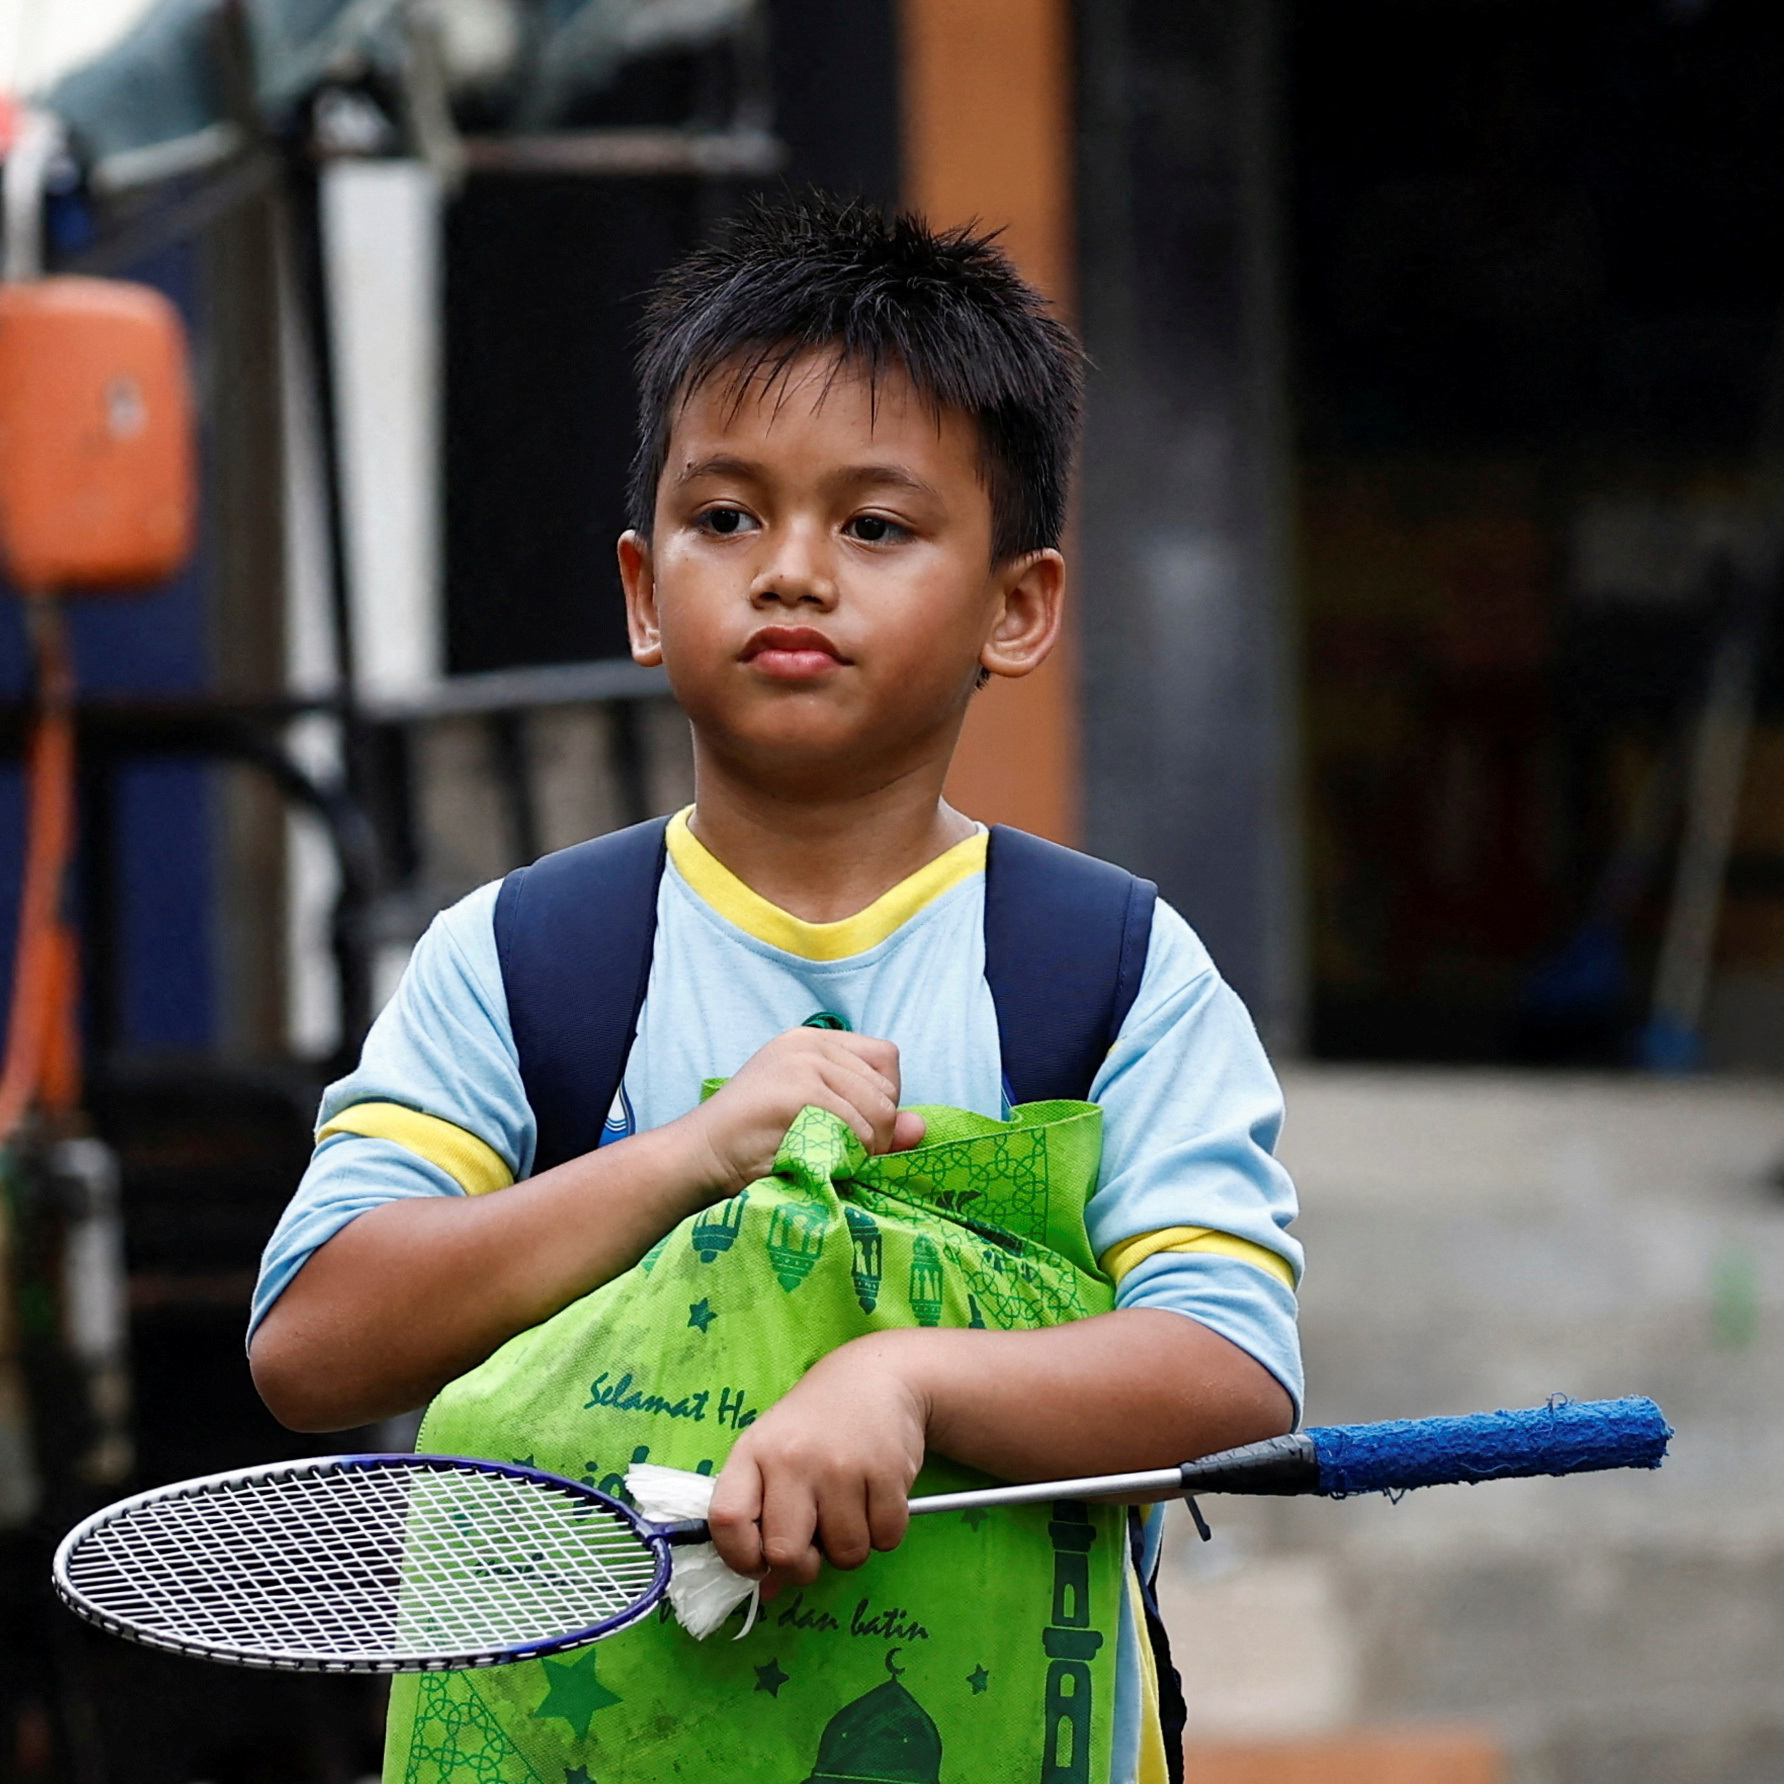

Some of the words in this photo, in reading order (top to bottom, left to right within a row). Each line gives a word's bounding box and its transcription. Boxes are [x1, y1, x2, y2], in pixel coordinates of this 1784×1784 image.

[583, 1371, 710, 1423] Selamat
[717, 1386, 758, 1430] Ha
[777, 1591, 840, 1633] dan
[850, 1597, 929, 1641] batin
